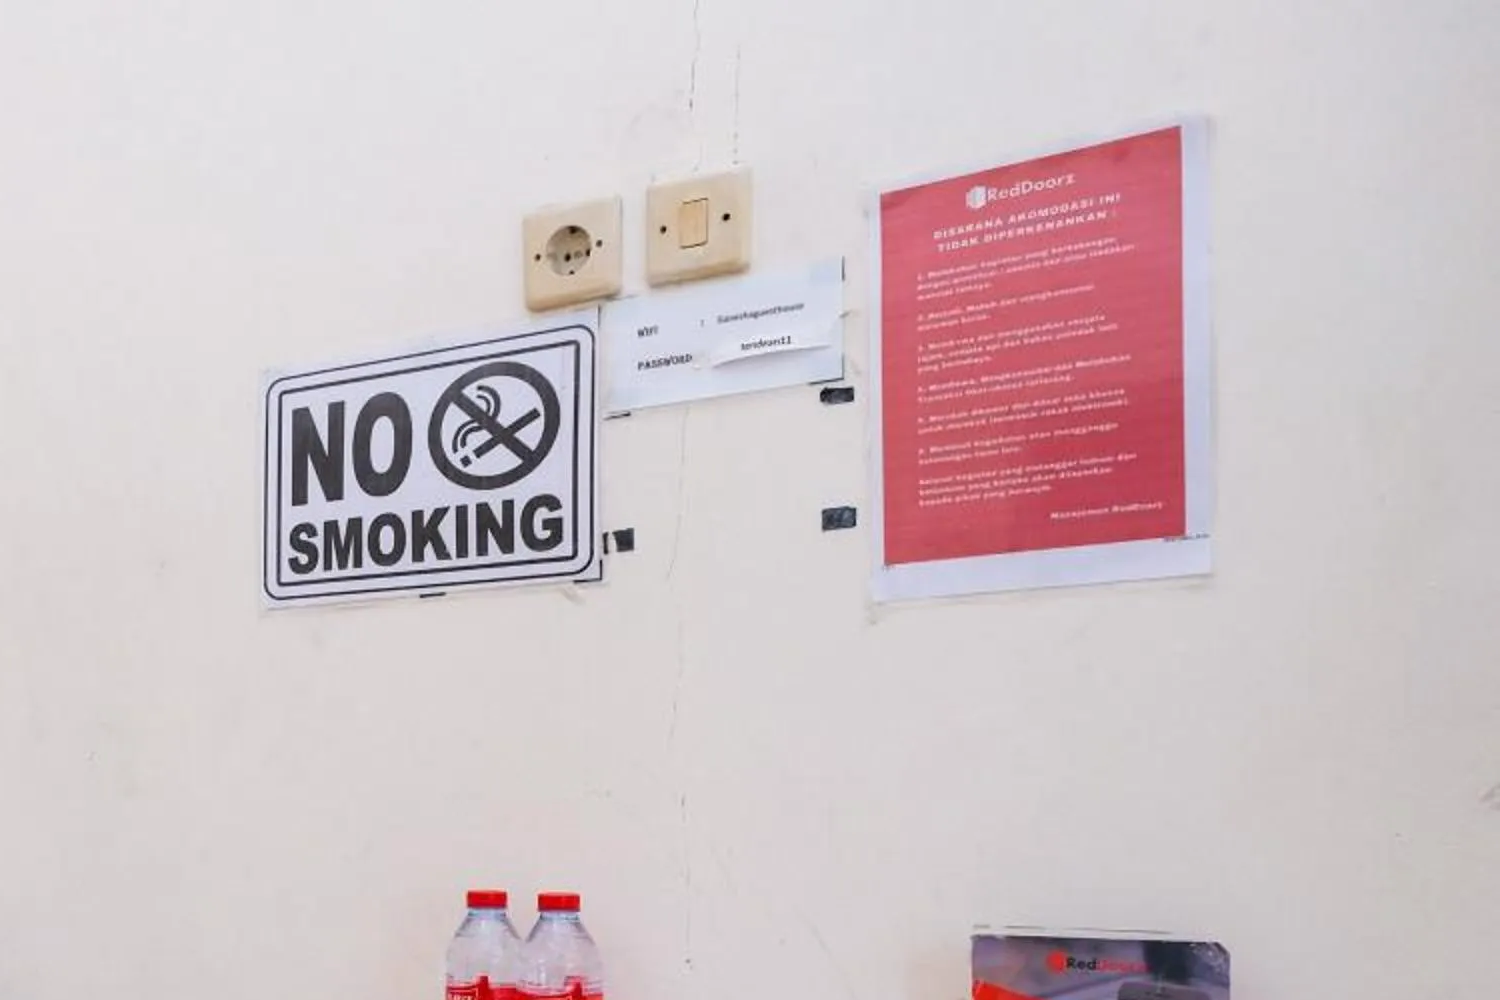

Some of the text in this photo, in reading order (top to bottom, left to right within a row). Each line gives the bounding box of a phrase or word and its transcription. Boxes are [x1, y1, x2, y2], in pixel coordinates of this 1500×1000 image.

[987, 173, 1076, 200] RedDoorz
[637, 353, 694, 371] PASSWORD
[291, 391, 413, 507] NO
[287, 493, 564, 575] SMOKING
